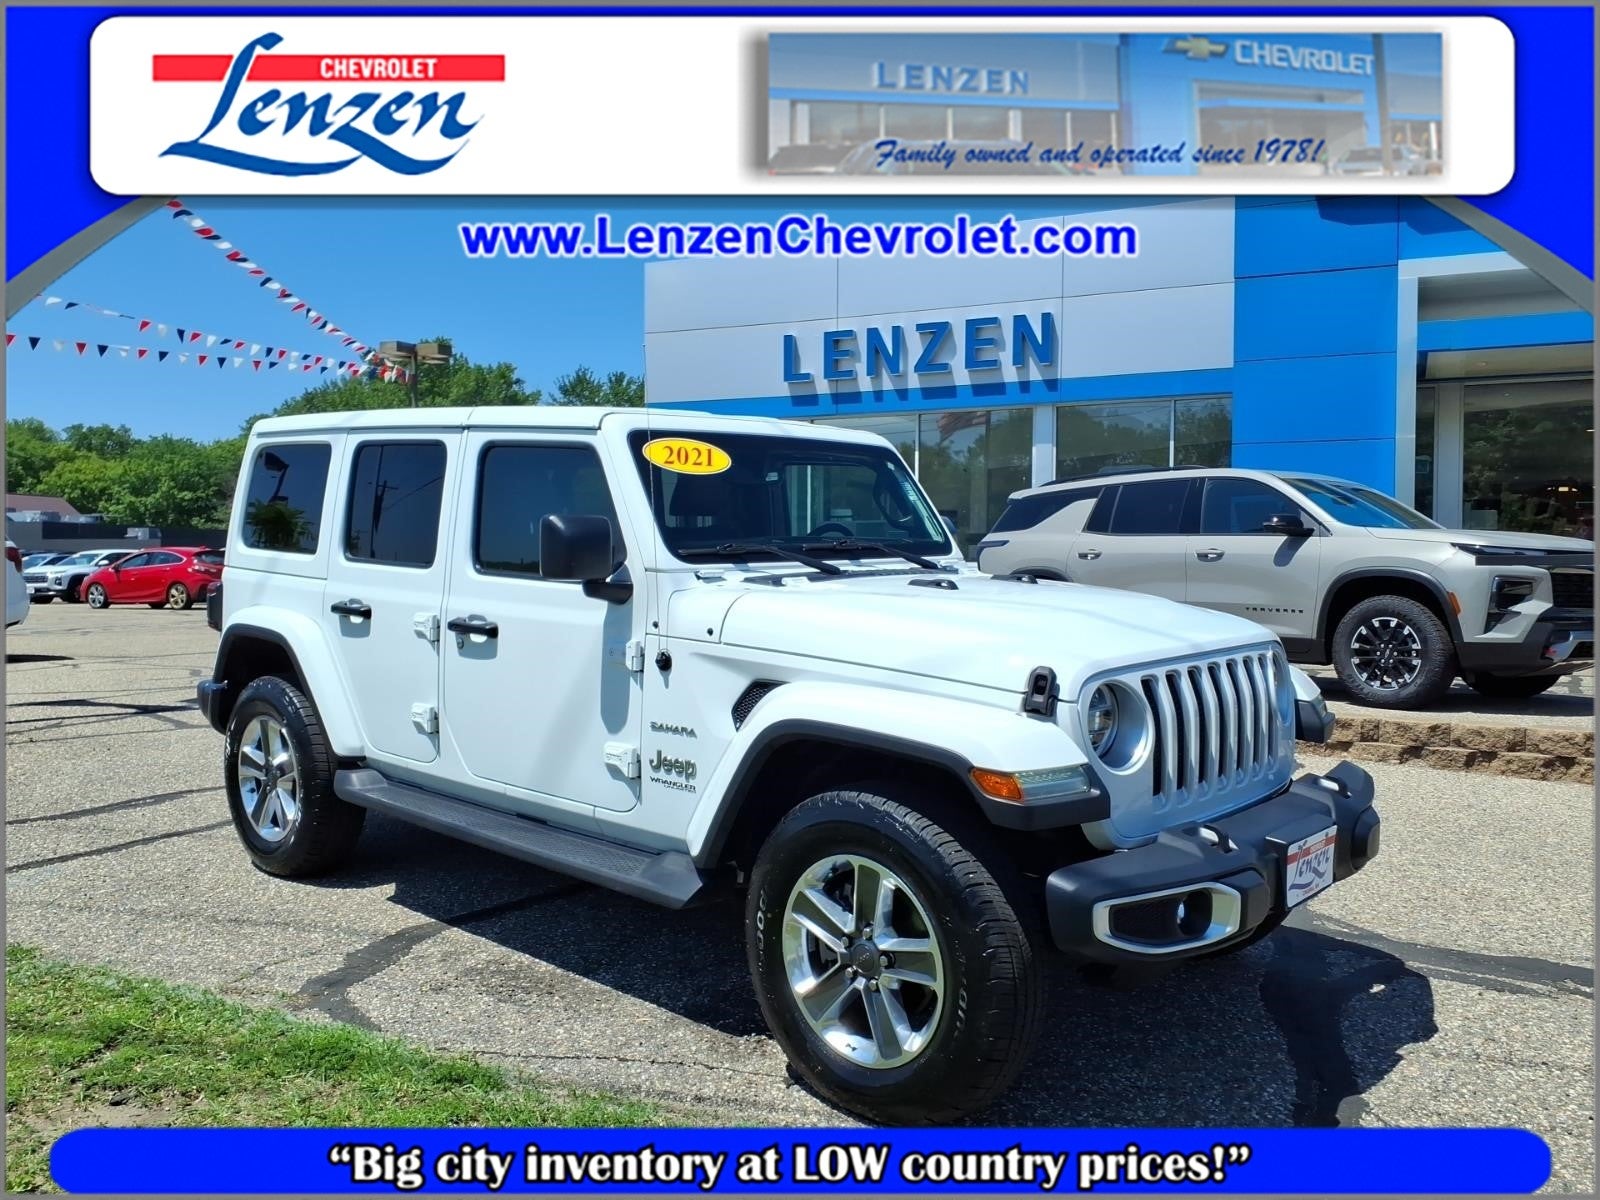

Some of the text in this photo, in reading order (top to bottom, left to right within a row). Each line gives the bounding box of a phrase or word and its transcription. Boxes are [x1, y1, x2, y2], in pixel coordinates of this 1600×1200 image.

[783, 312, 1056, 384] LENZEN
[662, 446, 714, 468] 2021
[1245, 606, 1305, 614] TRAVERSE
[650, 721, 697, 738] SAHARA
[649, 749, 697, 782] Jeep
[649, 775, 696, 791] WRANGLER
